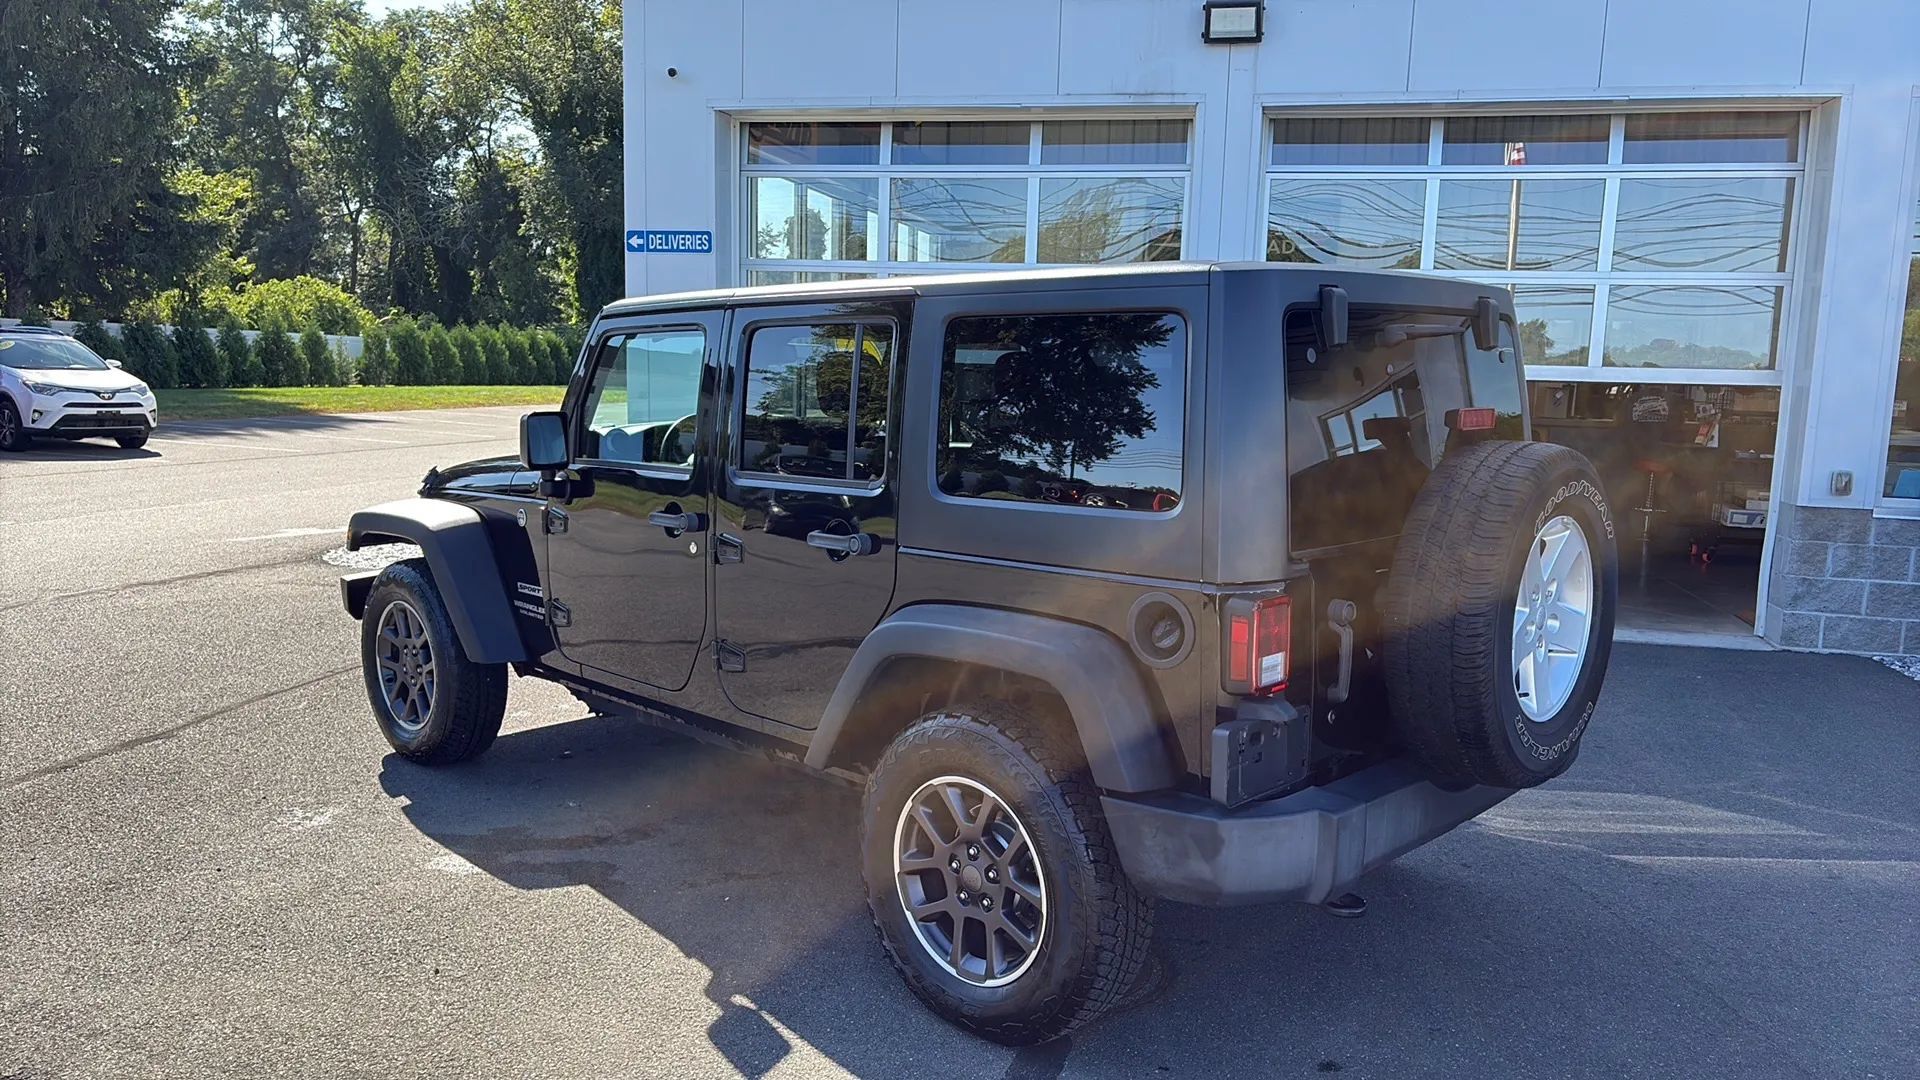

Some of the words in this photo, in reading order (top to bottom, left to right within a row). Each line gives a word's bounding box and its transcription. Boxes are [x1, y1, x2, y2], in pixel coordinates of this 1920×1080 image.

[648, 234, 709, 250] DELIVERIES
[1534, 479, 1615, 540] GOODYEAR
[518, 582, 543, 597] SPORT
[513, 599, 546, 614] WRANGLE
[1514, 701, 1594, 761] WRANGLER
